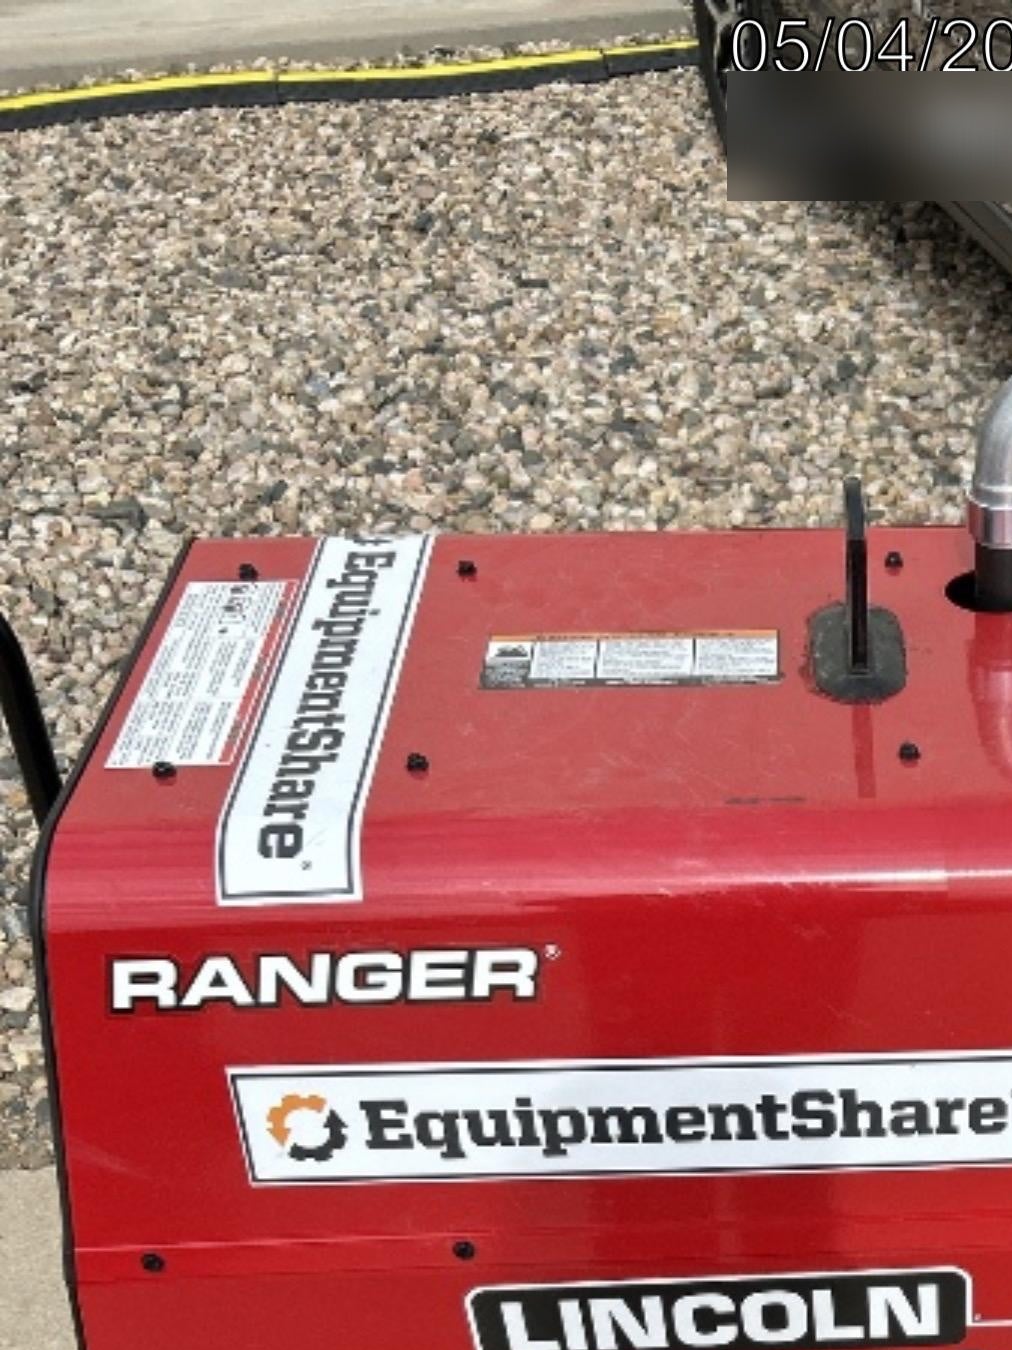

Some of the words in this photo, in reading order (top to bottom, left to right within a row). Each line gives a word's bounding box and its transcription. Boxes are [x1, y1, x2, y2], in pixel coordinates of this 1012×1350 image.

[257, 550, 396, 859] EquipmentShare
[110, 949, 540, 1010] RANGER
[359, 1089, 1009, 1159] EquipmentShare
